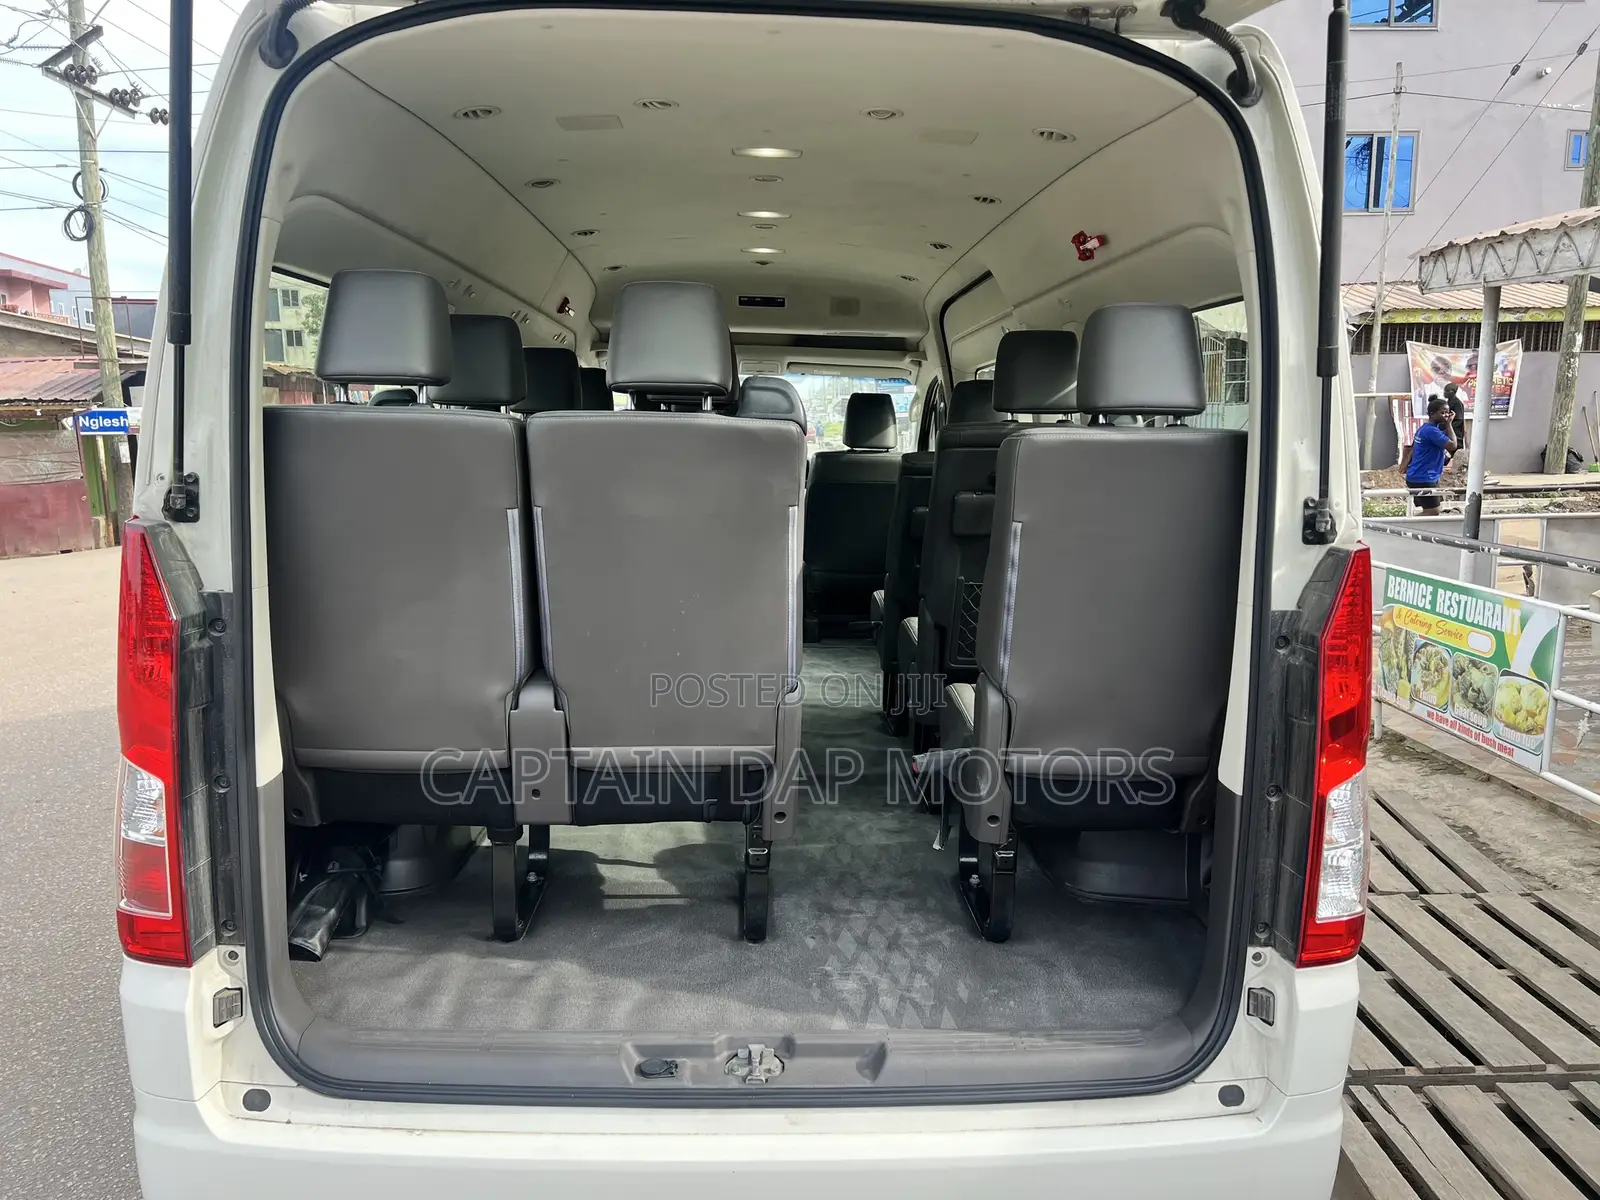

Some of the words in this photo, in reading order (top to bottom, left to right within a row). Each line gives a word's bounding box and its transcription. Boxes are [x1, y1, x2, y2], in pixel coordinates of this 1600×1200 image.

[79, 415, 128, 430] Nglesh
[1387, 575, 1433, 610] BERNICE
[1436, 588, 1521, 636] RESTUARANT
[1404, 609, 1433, 635] Catering
[1436, 619, 1464, 641] Service
[1426, 709, 1434, 720] we
[1436, 711, 1449, 726] have
[1457, 722, 1473, 738] kinds
[1474, 730, 1481, 742] of
[1481, 733, 1496, 750] bush
[1497, 742, 1515, 758] meat
